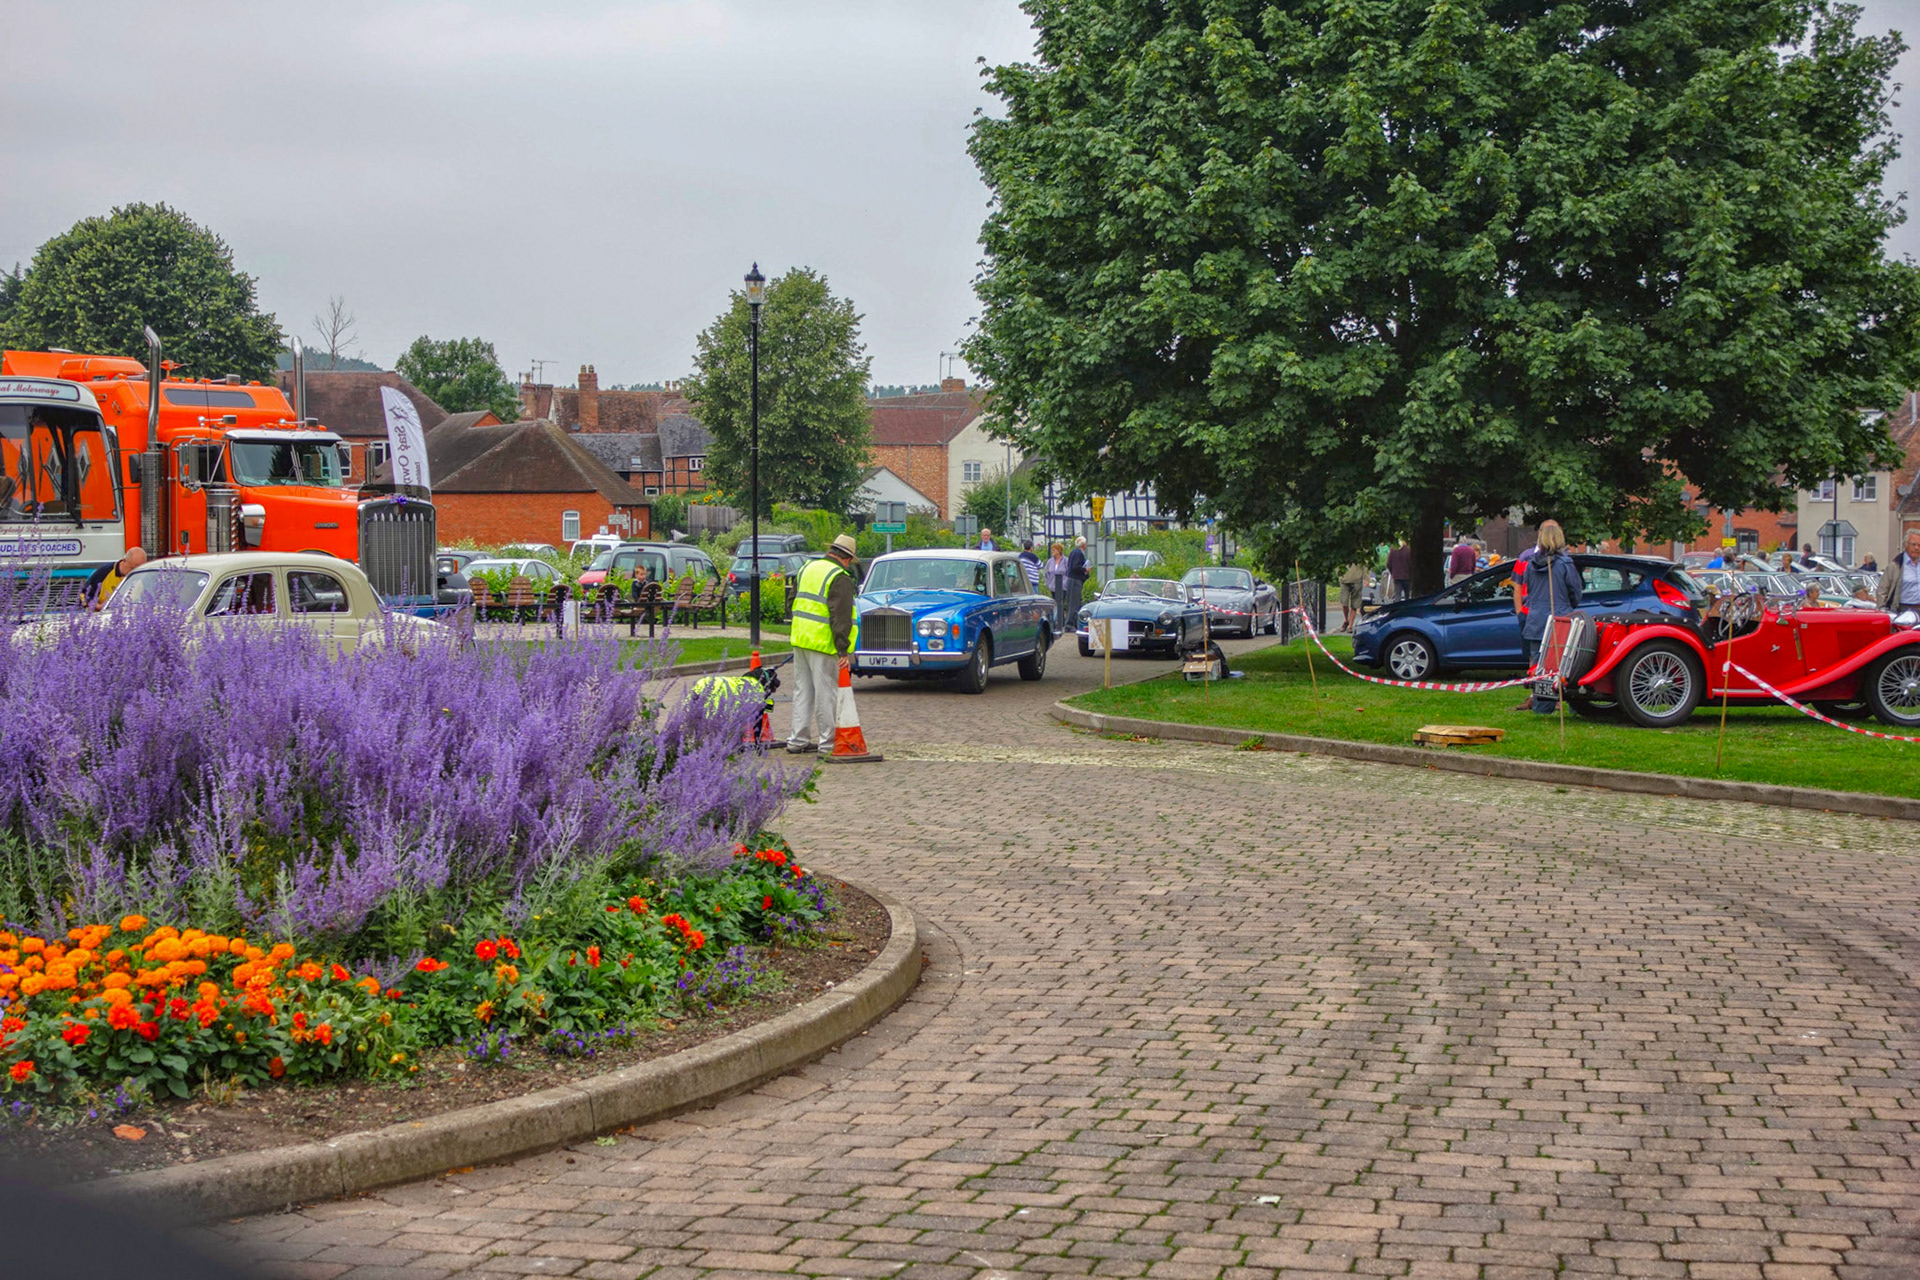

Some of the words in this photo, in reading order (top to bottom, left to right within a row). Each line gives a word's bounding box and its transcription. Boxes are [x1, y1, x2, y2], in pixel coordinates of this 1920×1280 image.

[40, 543, 77, 552] COACHES
[869, 657, 888, 666] UWP
[891, 657, 898, 666] 4
